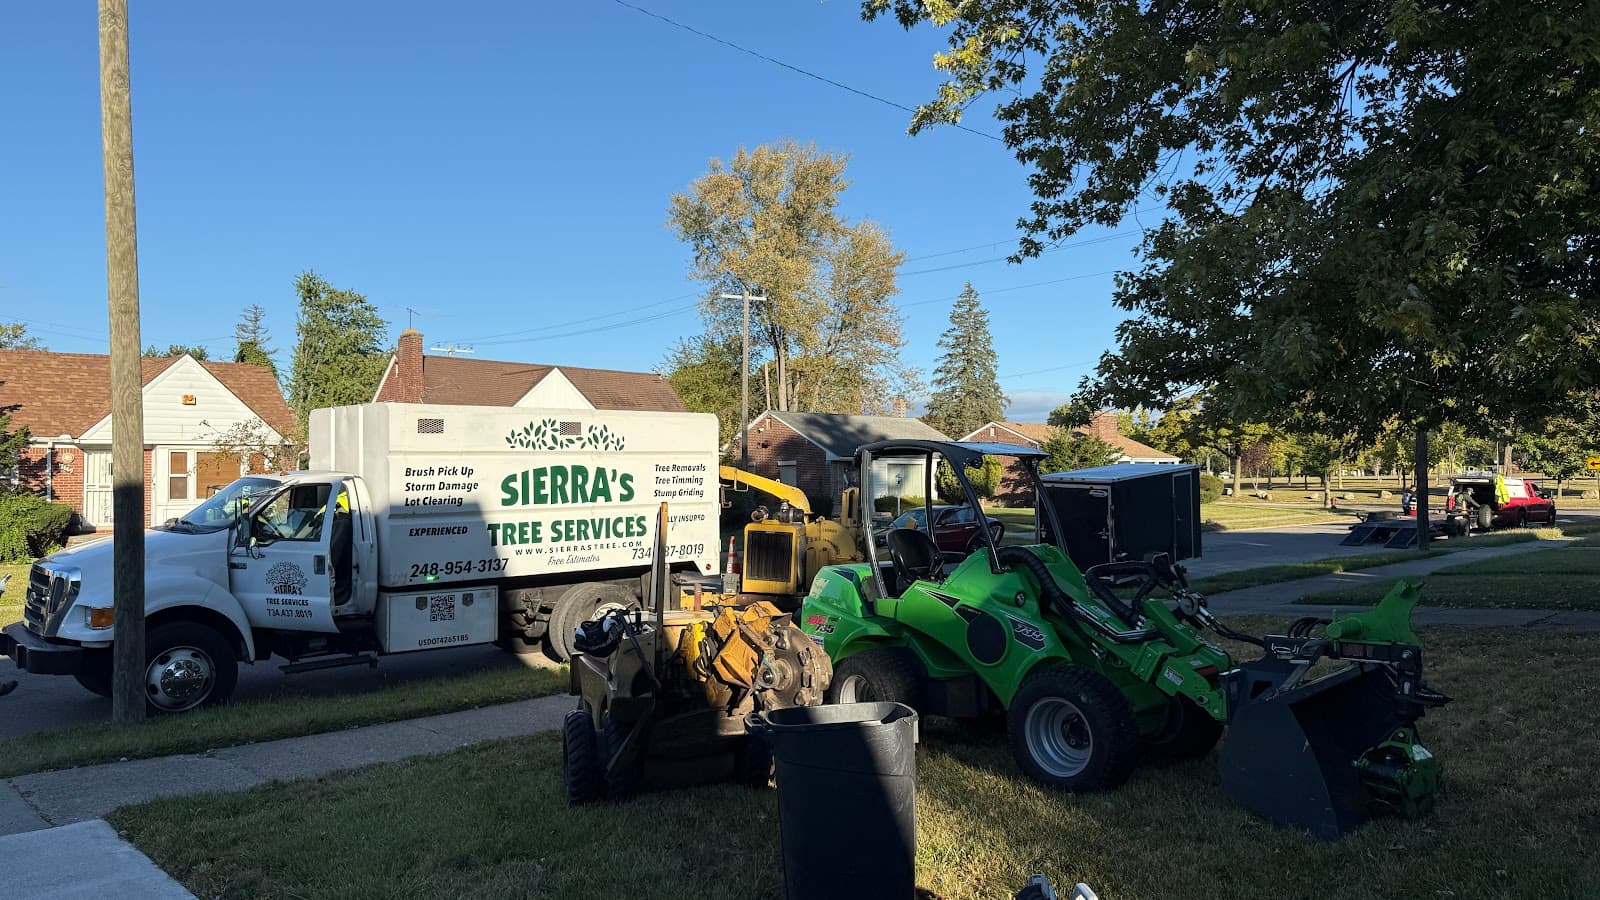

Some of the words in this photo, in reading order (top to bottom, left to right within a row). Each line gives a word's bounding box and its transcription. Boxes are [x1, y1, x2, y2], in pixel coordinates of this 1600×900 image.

[405, 466, 435, 477] Brush
[437, 465, 458, 476] Pick
[461, 466, 474, 478] Up
[655, 464, 670, 472] Tree
[671, 463, 706, 472] Removals
[501, 465, 635, 506] SIERRA'S
[655, 476, 670, 485] Tree
[672, 475, 704, 485] Timming
[405, 482, 435, 491] Storm
[438, 481, 479, 493] Damage
[654, 489, 677, 499] Stump
[678, 488, 704, 498] Griding
[405, 497, 421, 507] Lot
[423, 495, 463, 507] Clearing
[408, 526, 468, 537] EXPERIENCED
[487, 520, 543, 547] TREE
[550, 515, 648, 543] SERVICES
[515, 540, 643, 556] WWW.SIERRASTREE.COM
[547, 555, 565, 567] Free
[566, 554, 601, 565] Estimates
[410, 557, 509, 578] 248-954-3137
[273, 584, 303, 596] SIERRA'S
[266, 597, 280, 605] TREE
[281, 598, 309, 606] SERVICES
